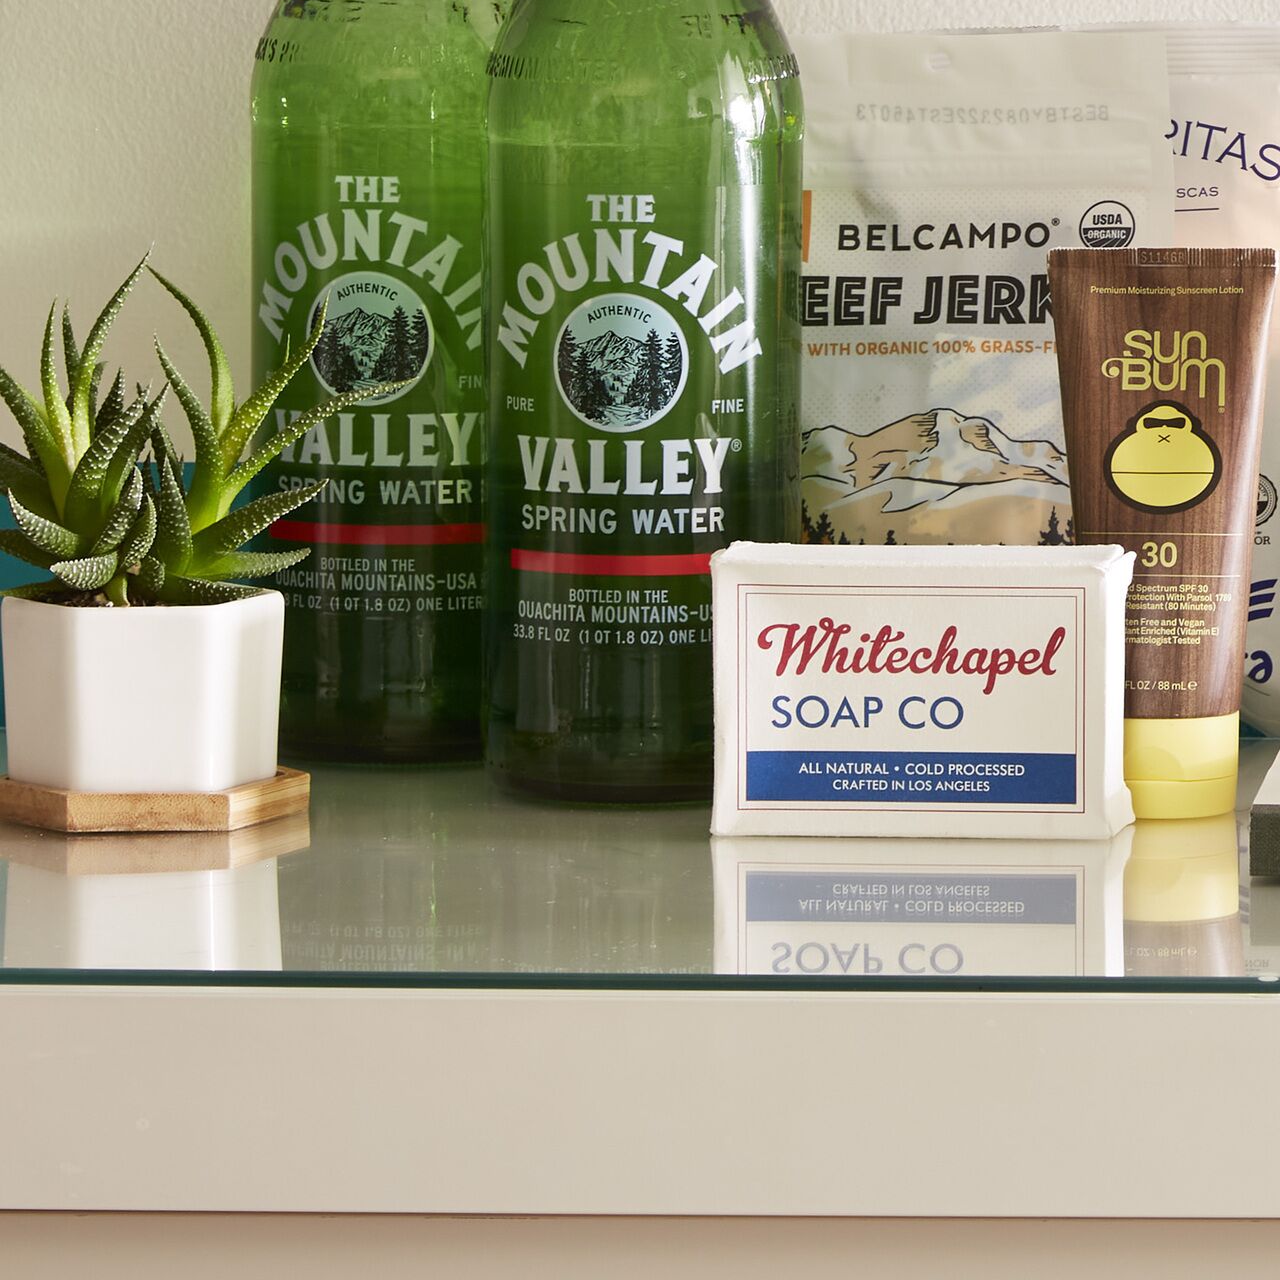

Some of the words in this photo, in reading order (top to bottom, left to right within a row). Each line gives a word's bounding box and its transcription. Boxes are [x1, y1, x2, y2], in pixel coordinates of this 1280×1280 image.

[334, 175, 401, 205] THE
[586, 193, 656, 224] THE
[1092, 213, 1123, 226] USDA
[1088, 228, 1126, 240] ORGANIC
[336, 283, 399, 302] AUTHENTIC
[1090, 285, 1127, 294] Premium
[1128, 286, 1176, 296] Moisturizing
[1176, 286, 1218, 294] Sunscreen
[1218, 286, 1244, 294] Lotion
[497, 228, 764, 376] MOUNTAIN
[586, 304, 653, 326] AUTHENTIC
[807, 342, 850, 356] WITH
[855, 340, 928, 356] ORGANIC
[932, 340, 976, 354] 100%
[506, 395, 535, 412] PURE
[711, 398, 745, 414] FINE
[380, 480, 473, 506] WATER
[522, 503, 617, 534] SPRING
[632, 506, 726, 534] WATER
[1140, 541, 1178, 568] 30
[569, 588, 622, 604] BOTTLED
[626, 590, 640, 604] IN
[644, 590, 668, 604] THE
[518, 600, 585, 622] OUACHITA
[756, 617, 1066, 696] Whitechapel
[770, 695, 884, 730] SOAP
[897, 695, 965, 730] CO
[798, 762, 822, 776] ALL
[825, 762, 890, 776] NATURAL
[904, 763, 945, 777] COLD
[948, 763, 1025, 777] PROCESSED
[832, 779, 888, 792] CRAFTED
[890, 779, 905, 792] IN
[908, 779, 932, 792] LOS
[934, 780, 990, 792] ANGELES
